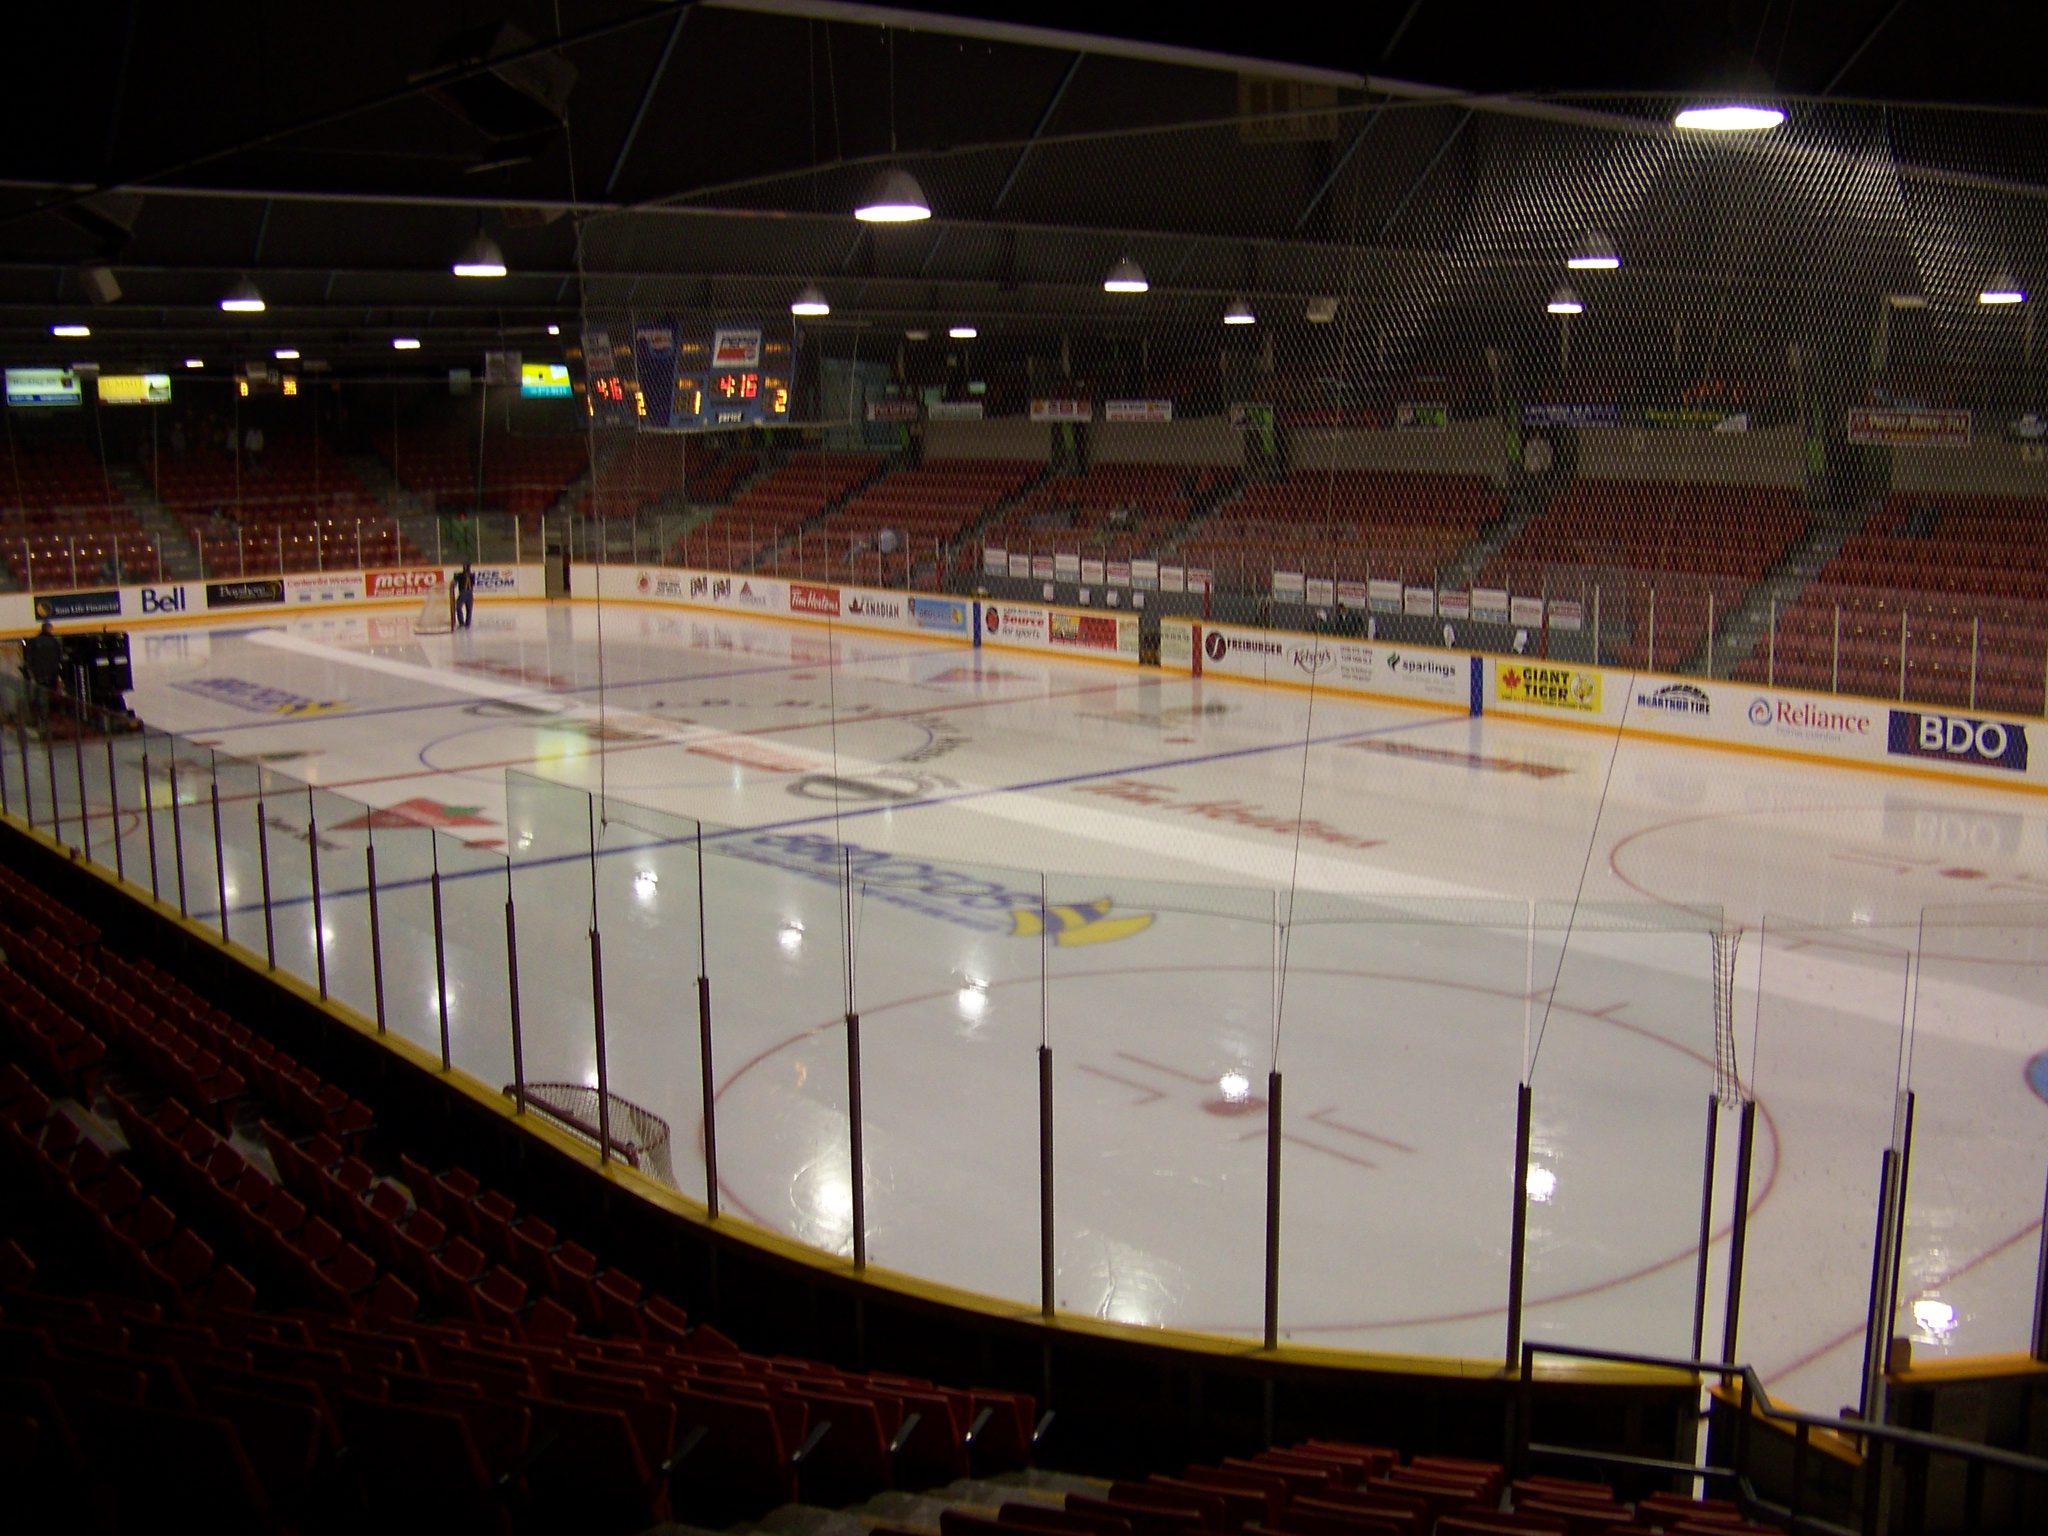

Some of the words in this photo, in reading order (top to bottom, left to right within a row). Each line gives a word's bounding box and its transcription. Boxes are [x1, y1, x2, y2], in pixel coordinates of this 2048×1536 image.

[775, 388, 788, 413] 2
[375, 571, 437, 588] metro
[71, 604, 84, 614] Life
[86, 602, 118, 613] Financial
[141, 586, 186, 613] Bell
[861, 600, 899, 619] CANADIAN
[1002, 613, 1044, 629] Source
[1014, 627, 1040, 641] sports
[1402, 659, 1456, 679] sparlings
[1523, 667, 1570, 685] GIANT
[1523, 684, 1569, 701] TIGER
[1689, 698, 1711, 715] TIRE
[1776, 698, 1870, 735] Reliance
[1920, 715, 2007, 759] BDO
